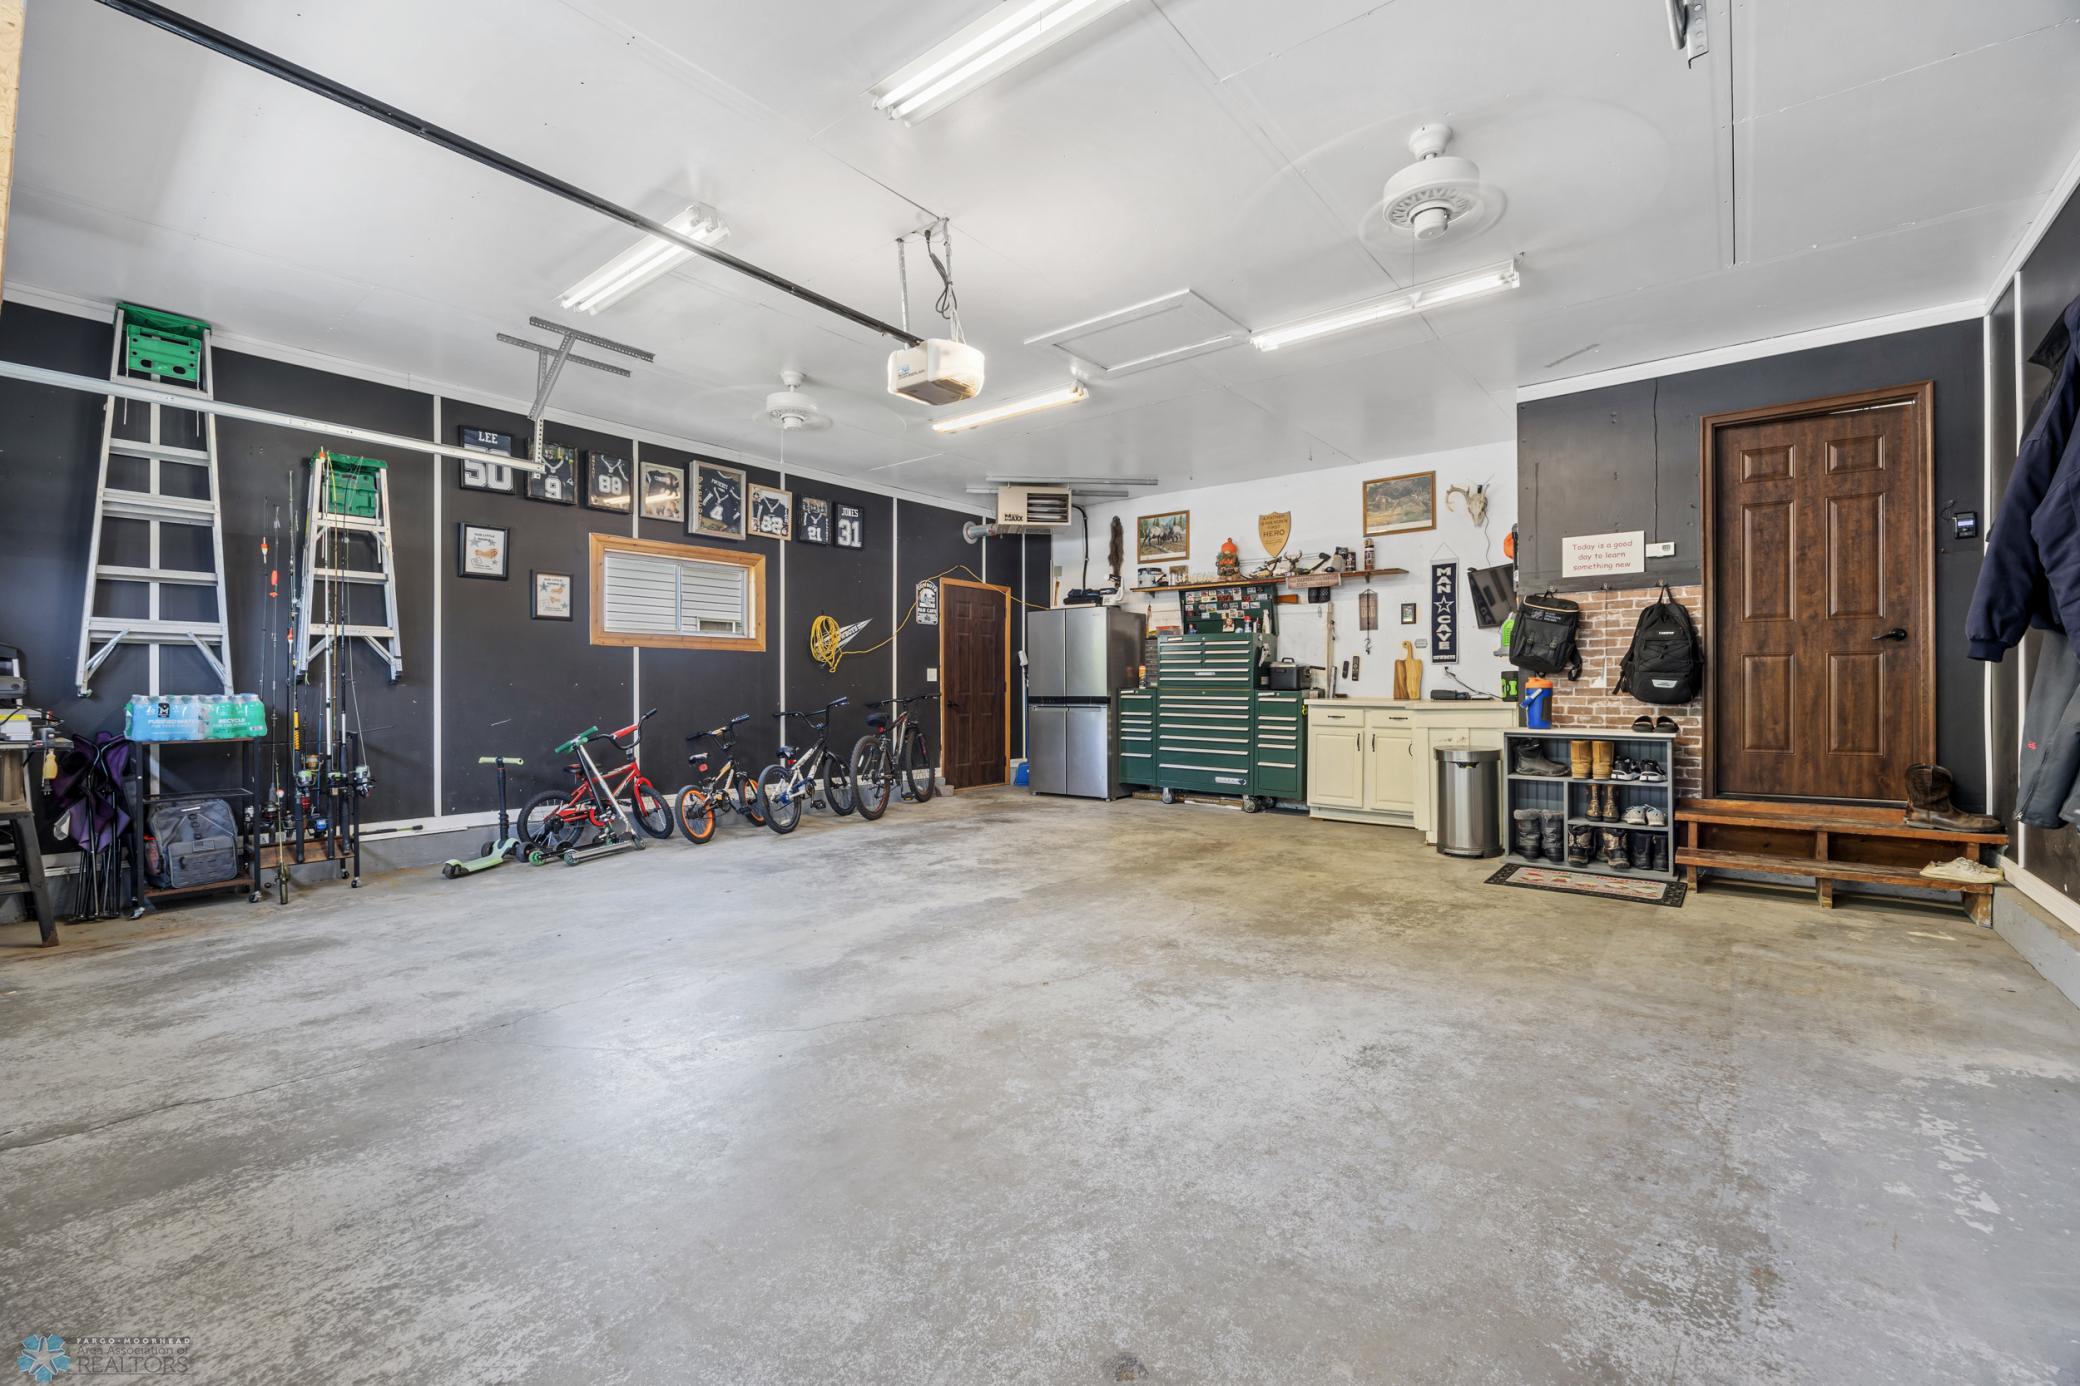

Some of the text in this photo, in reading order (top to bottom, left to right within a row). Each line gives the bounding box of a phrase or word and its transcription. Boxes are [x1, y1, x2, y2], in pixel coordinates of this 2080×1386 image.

[479, 431, 498, 444] LEE
[464, 443, 513, 491] 50
[545, 477, 562, 500] 9
[599, 474, 622, 495] 88
[842, 507, 859, 518] JONES
[807, 525, 822, 542] 21
[838, 519, 862, 548] 31
[1263, 529, 1286, 538] HERO
[1572, 543, 1595, 551] Today
[1613, 540, 1633, 550] good
[1573, 563, 1613, 571] something
[1436, 567, 1452, 594] MAN
[1436, 615, 1453, 650] CAVE
